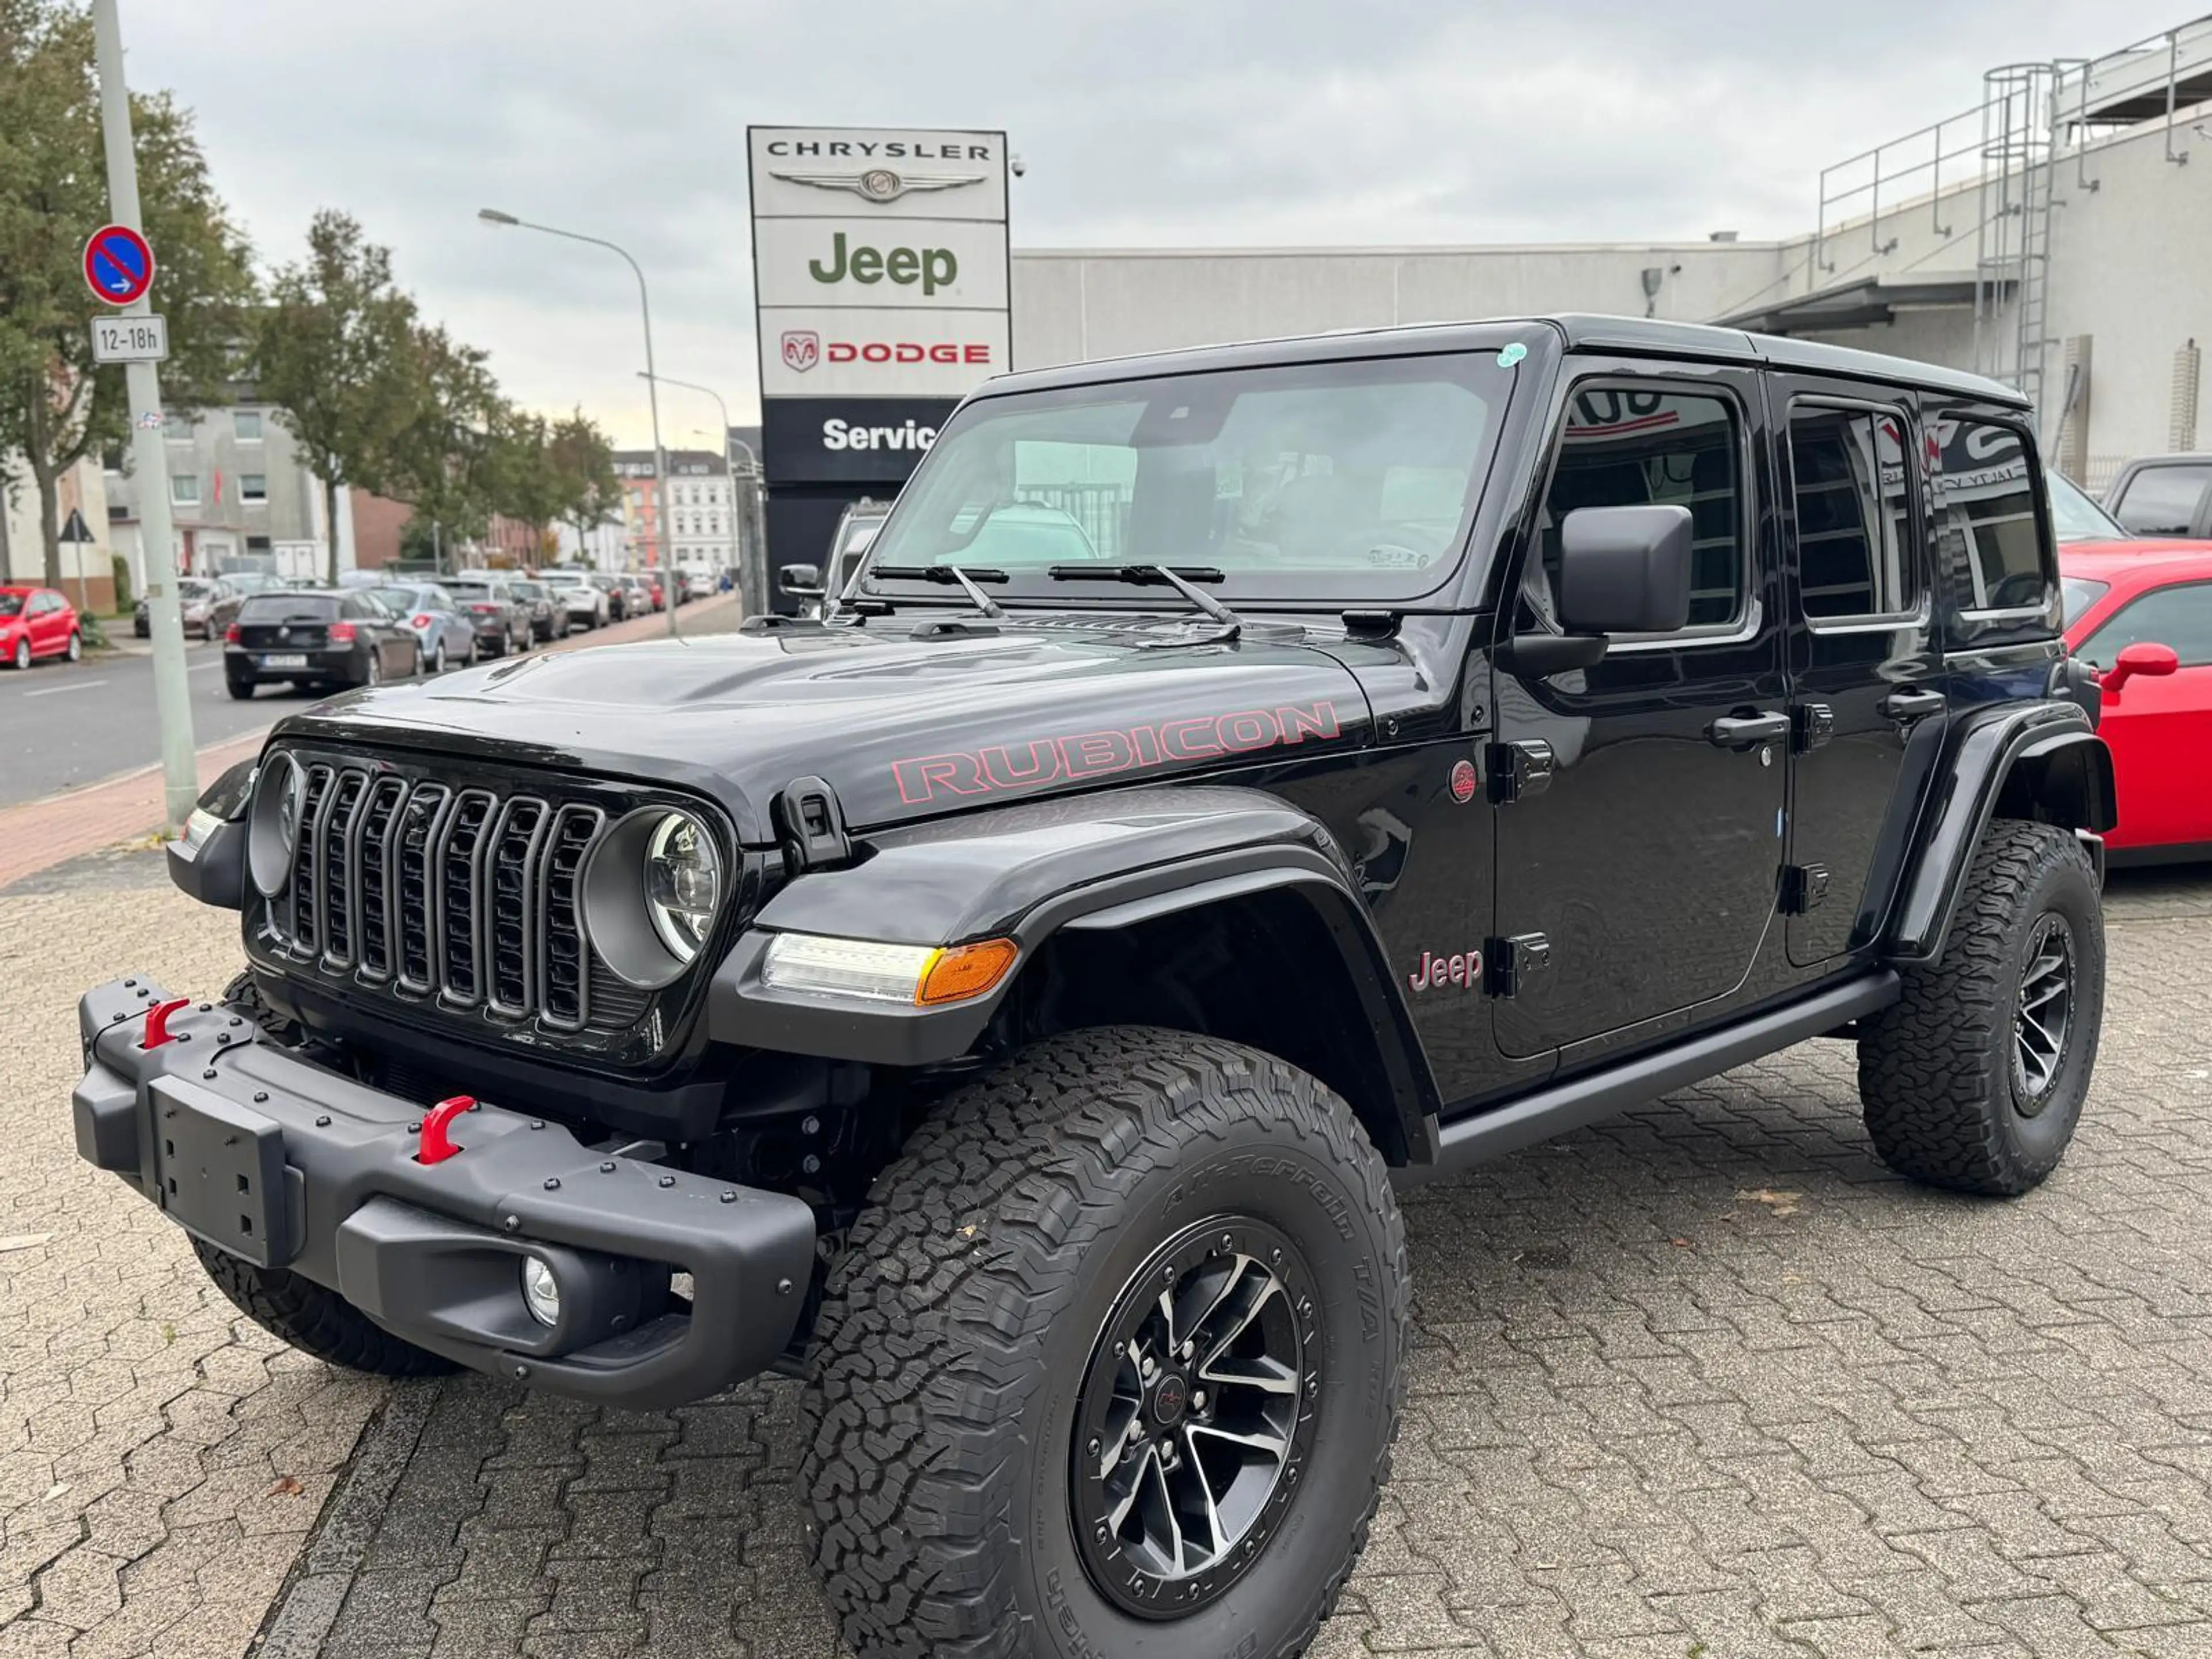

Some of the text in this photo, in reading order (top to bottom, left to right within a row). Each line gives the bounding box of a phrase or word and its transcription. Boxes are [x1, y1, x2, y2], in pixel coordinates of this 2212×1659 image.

[767, 142, 991, 160] CHRYSLER
[809, 233, 958, 296] Jeep
[100, 327, 157, 350] 12-18h
[828, 343, 991, 363] DODGE
[823, 418, 935, 450] Servic
[892, 700, 1341, 804] RUBICON
[1407, 950, 1483, 993] Jeep
